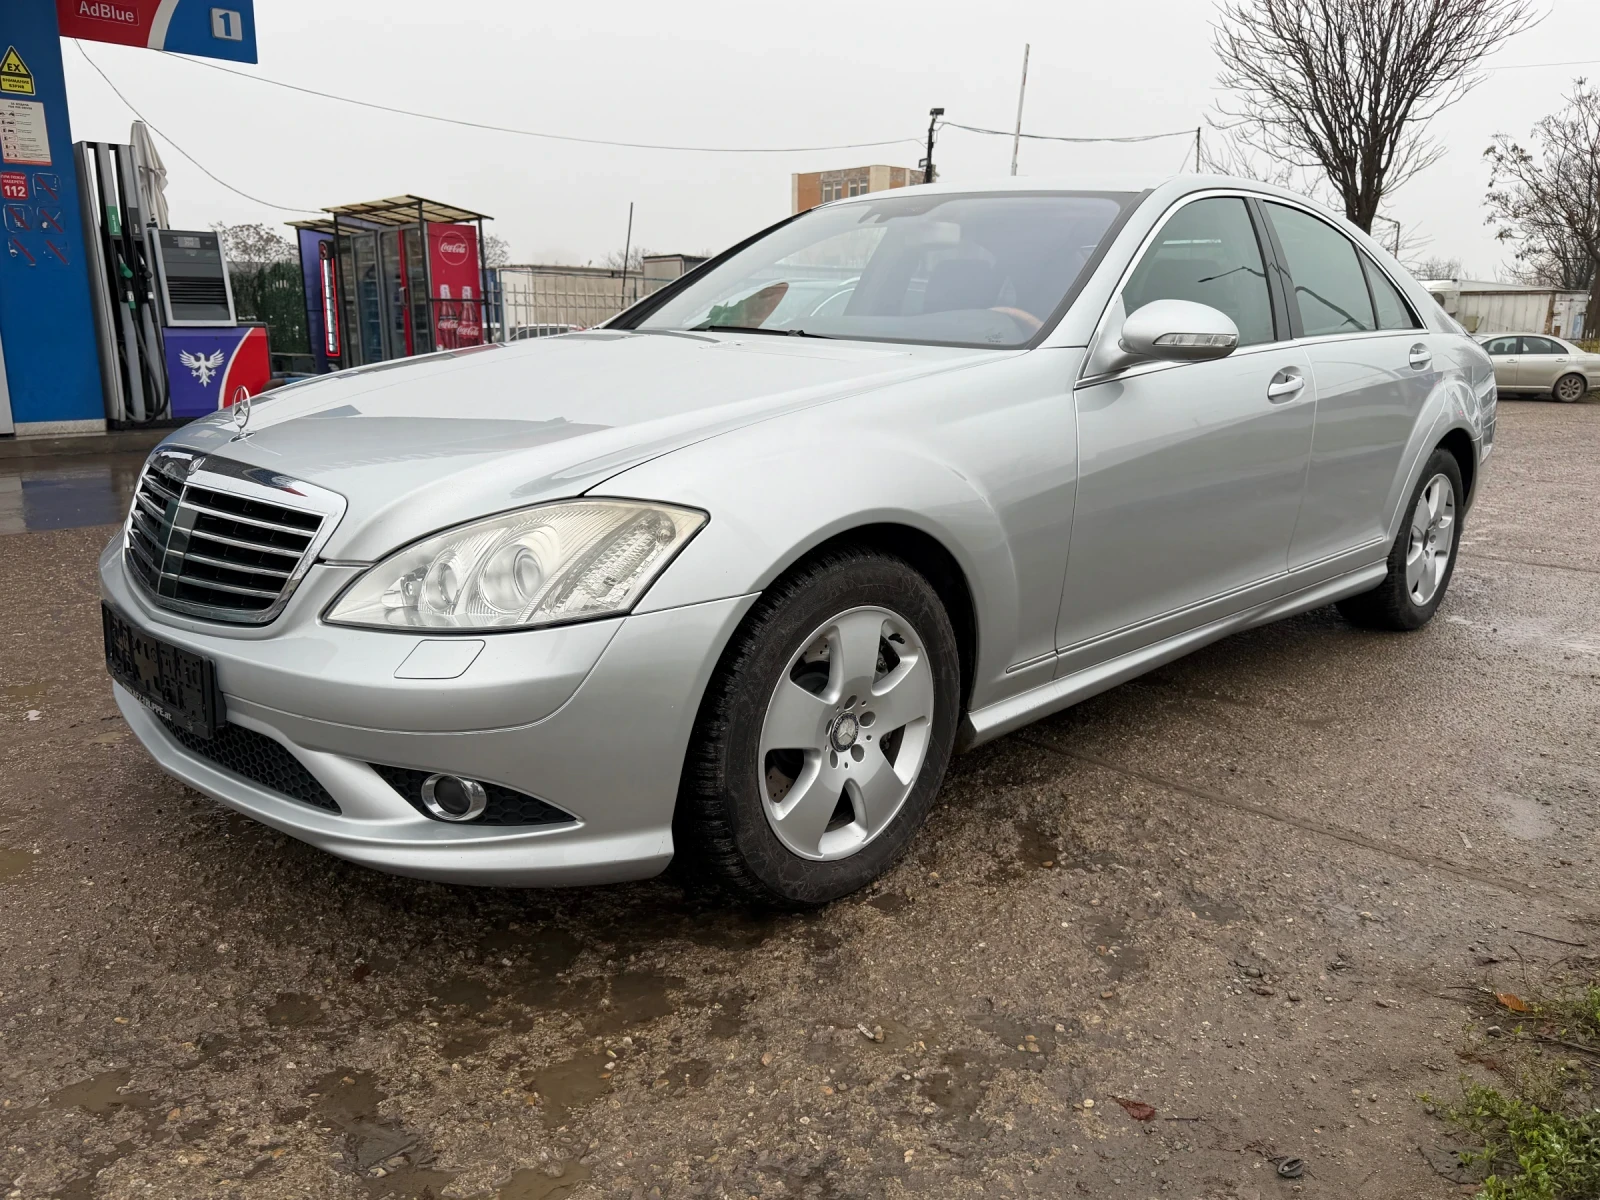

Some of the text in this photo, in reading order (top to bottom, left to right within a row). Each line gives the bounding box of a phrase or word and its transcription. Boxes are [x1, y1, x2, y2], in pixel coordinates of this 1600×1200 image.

[79, 0, 135, 22] AdBlue
[219, 12, 232, 37] 1
[7, 63, 21, 72] EX
[4, 185, 26, 197] 112
[441, 242, 466, 253] Coca-Cola
